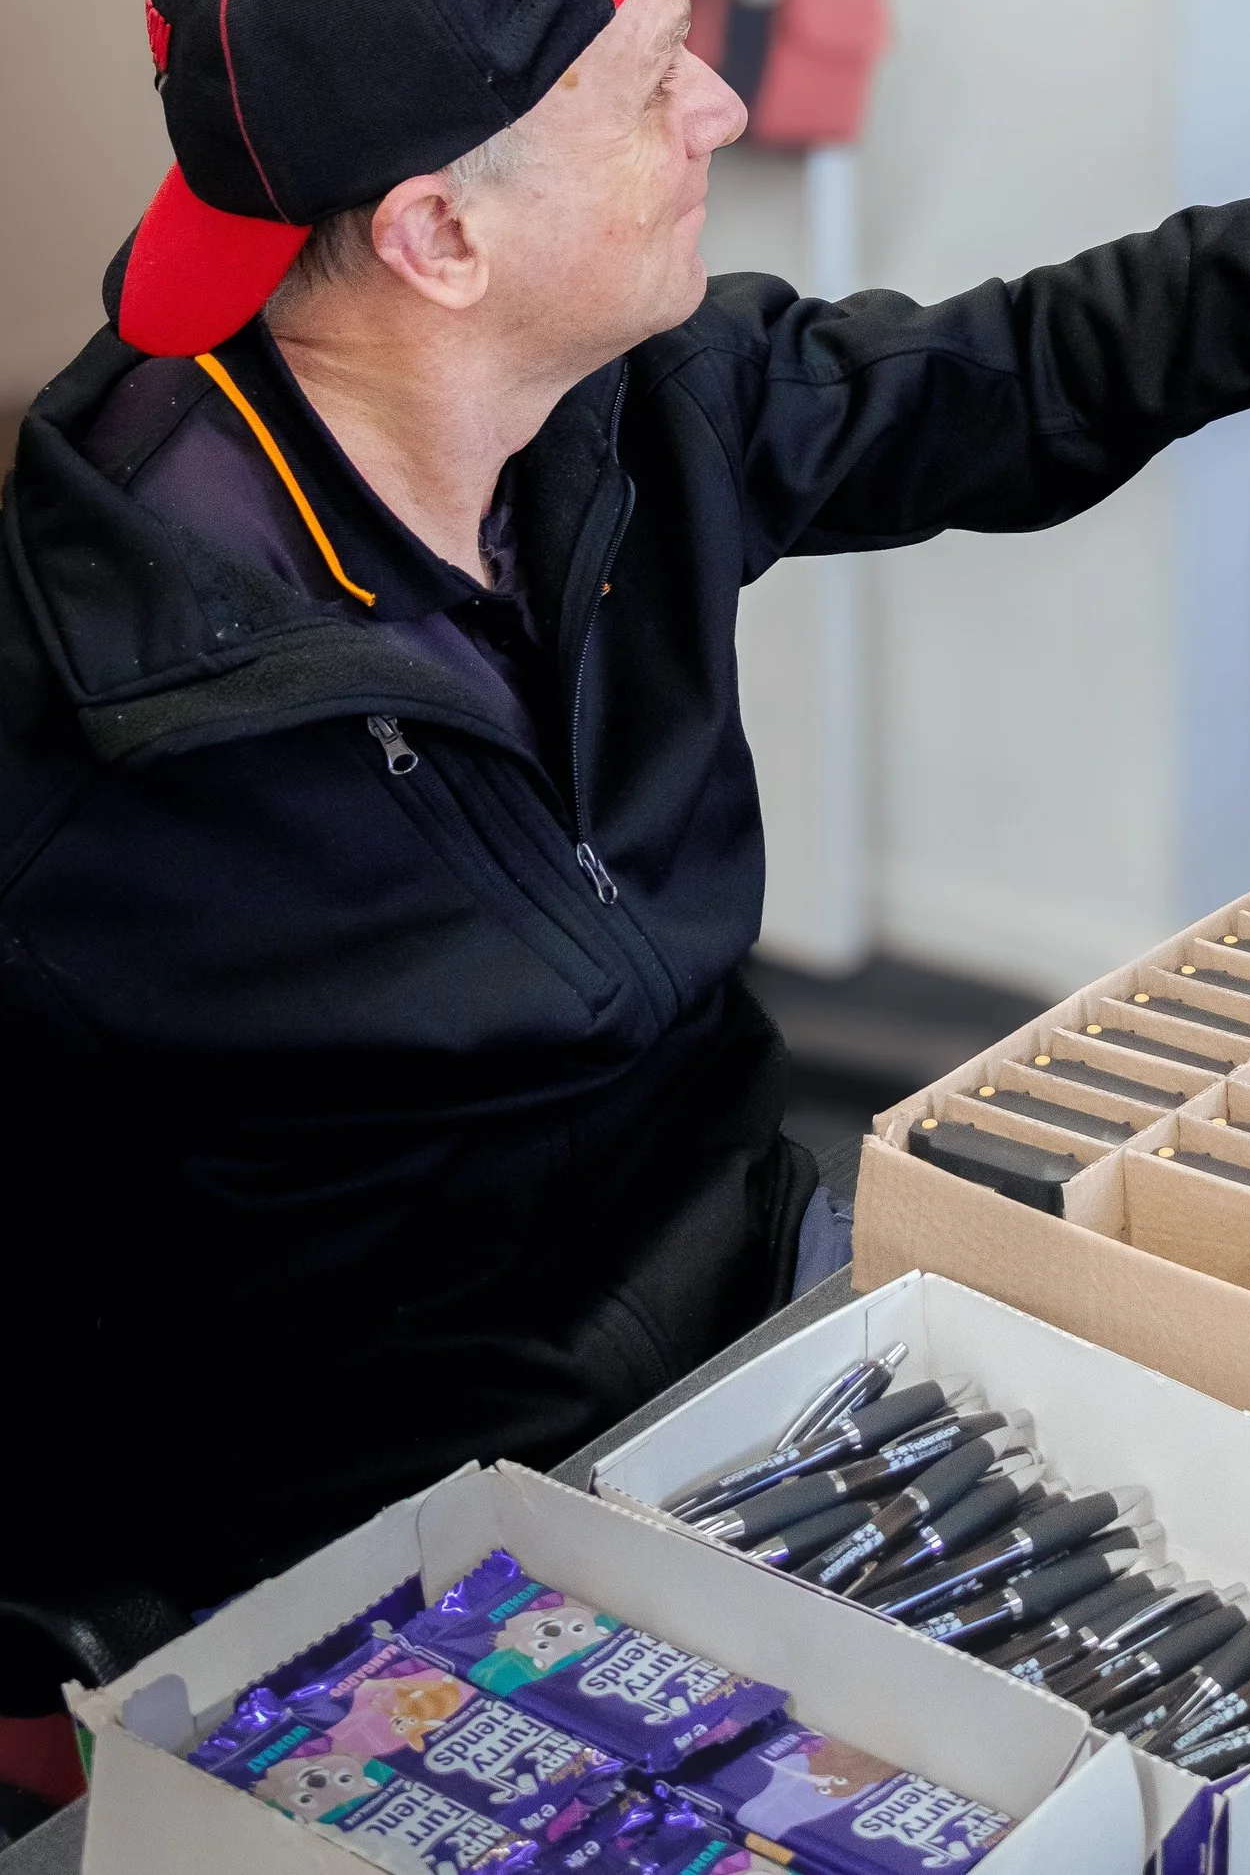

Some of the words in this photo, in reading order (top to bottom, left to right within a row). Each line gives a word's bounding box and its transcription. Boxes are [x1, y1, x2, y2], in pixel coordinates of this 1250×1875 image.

[906, 1424, 961, 1452] Federation
[717, 1458, 775, 1488] Federation
[818, 1543, 866, 1583] Federation
[486, 1583, 542, 1625] WOMBAT
[328, 1643, 401, 1698] KANGAROO
[584, 1633, 663, 1693] riends
[622, 1646, 695, 1699] Furry
[674, 1658, 712, 1688] ILK
[686, 1664, 729, 1703] AIRY
[246, 1724, 311, 1774] WOMBAT
[431, 1704, 515, 1768] riends
[470, 1719, 546, 1773] Furry
[533, 1738, 582, 1781] AIRY
[404, 1801, 468, 1848] Furr
[859, 1777, 939, 1833] riends
[899, 1791, 972, 1839] Furry
[951, 1804, 994, 1830] ILK
[453, 1824, 507, 1868] AIRY
[965, 1808, 1009, 1847] AIRY
